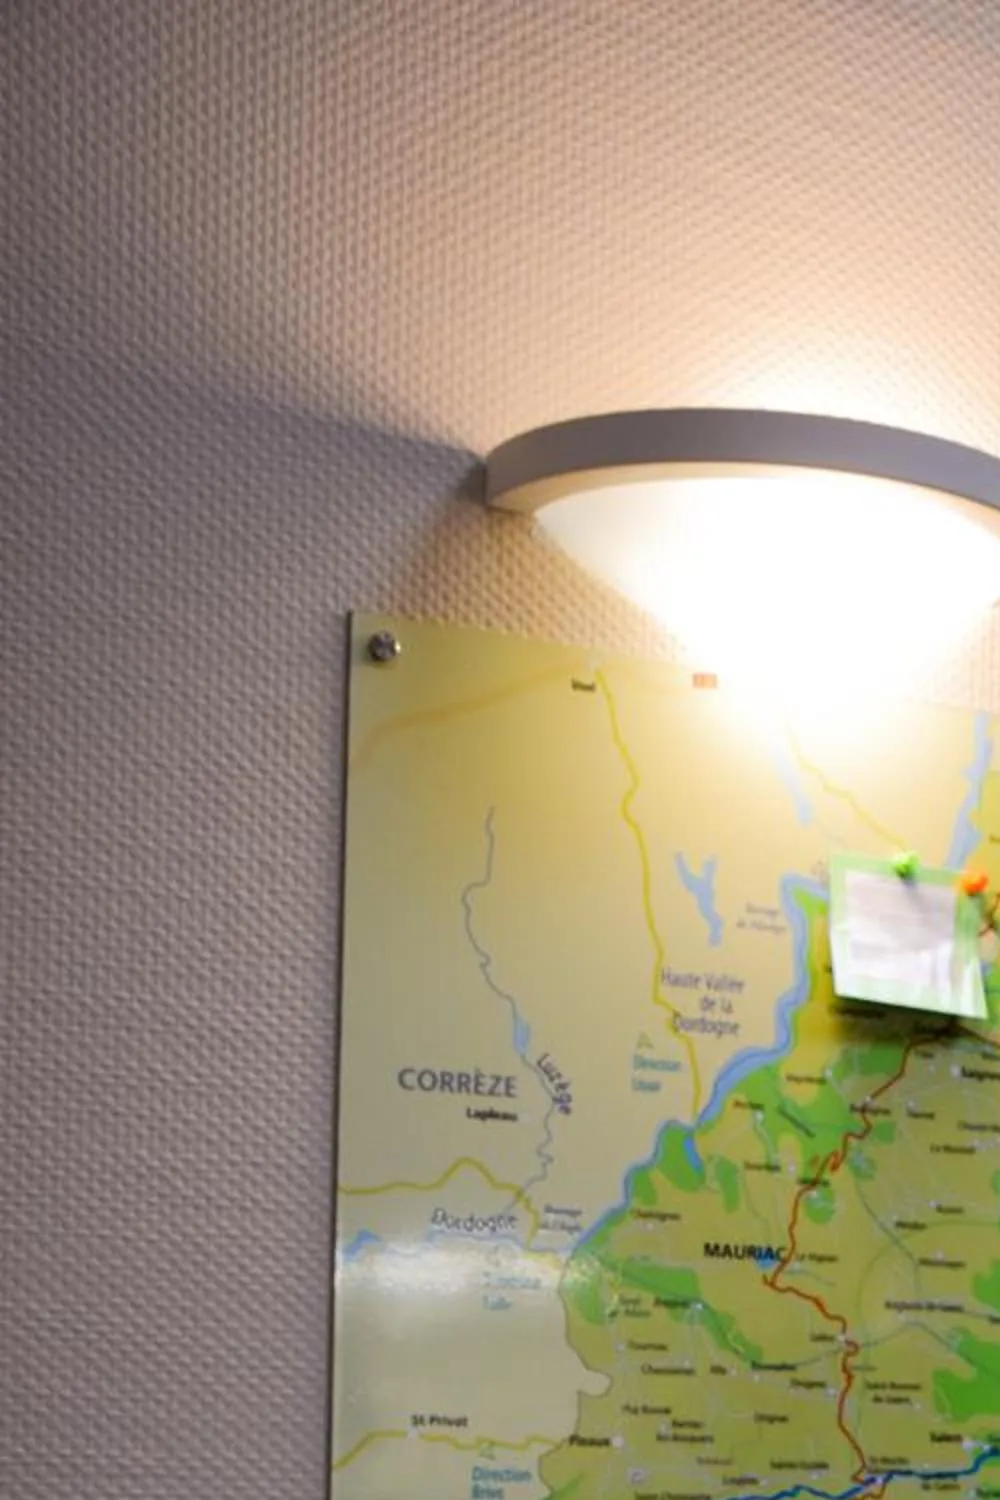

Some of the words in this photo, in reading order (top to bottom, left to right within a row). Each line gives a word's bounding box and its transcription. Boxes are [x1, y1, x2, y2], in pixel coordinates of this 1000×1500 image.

[397, 1066, 518, 1098] CORRÈZE
[431, 1207, 519, 1231] Dordogne
[704, 1242, 787, 1262] MAURIAC
